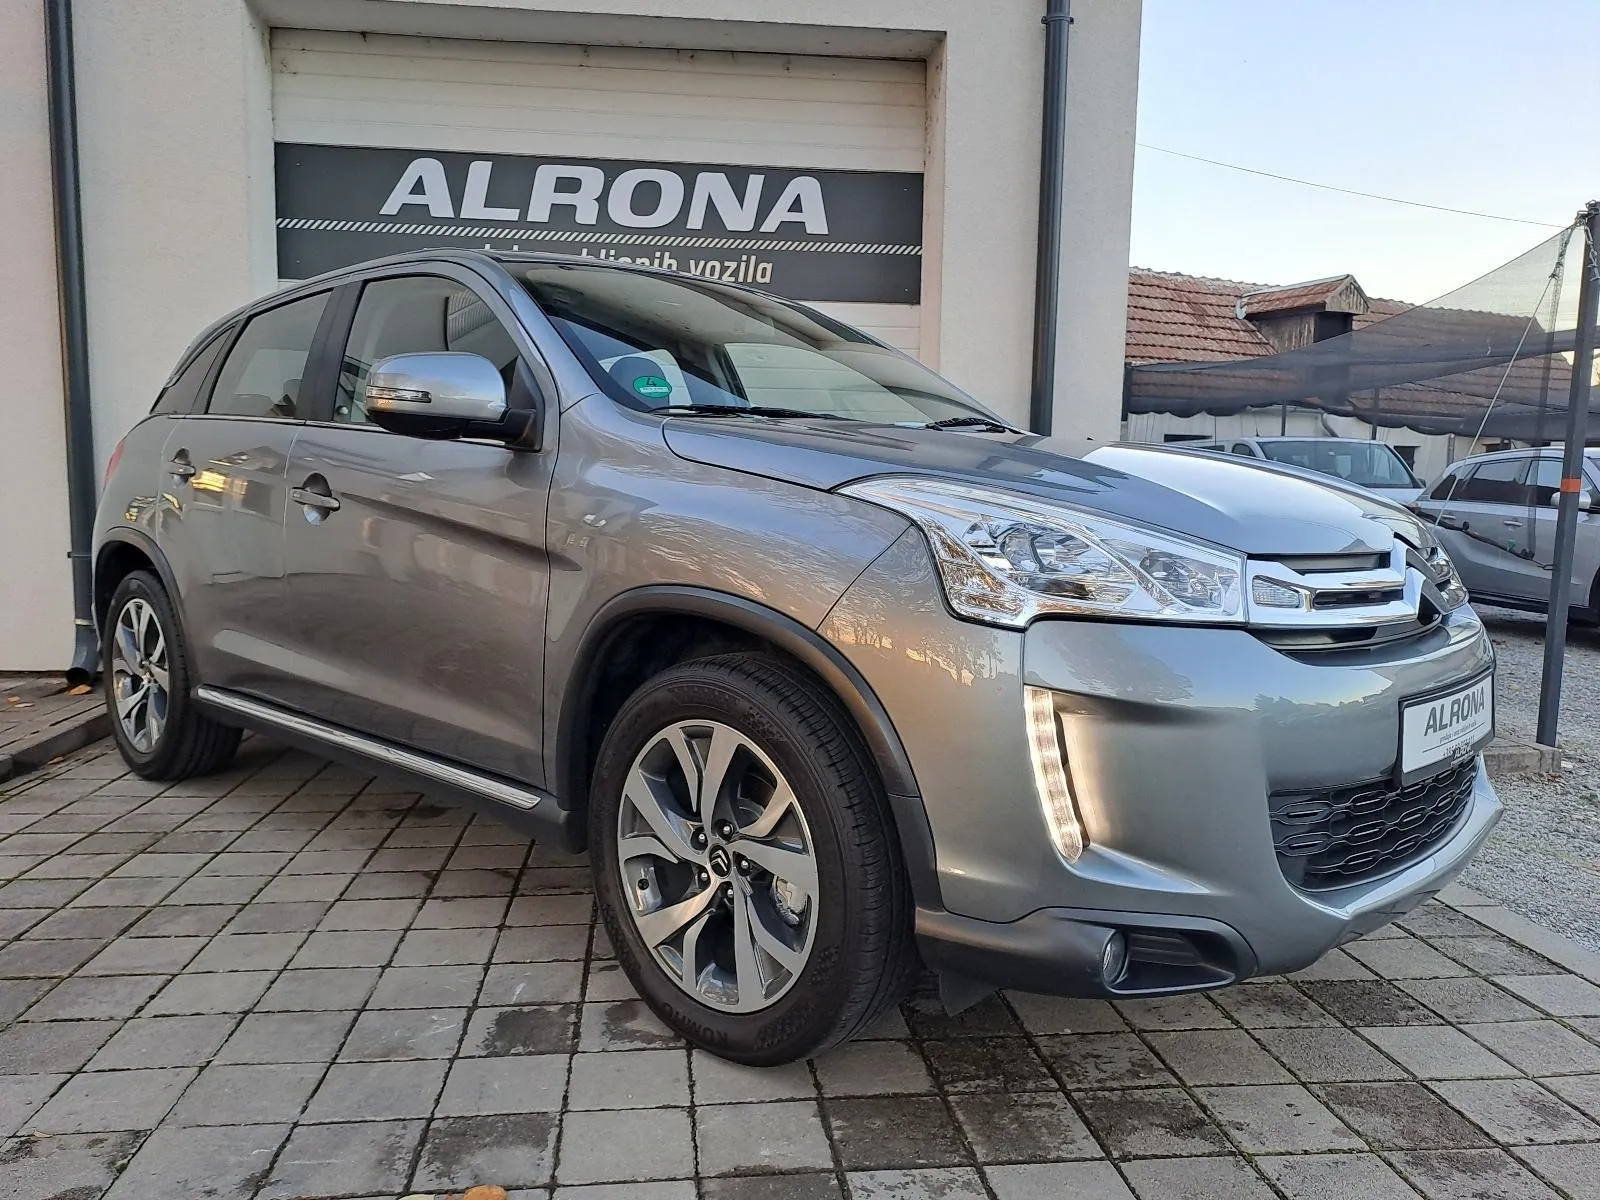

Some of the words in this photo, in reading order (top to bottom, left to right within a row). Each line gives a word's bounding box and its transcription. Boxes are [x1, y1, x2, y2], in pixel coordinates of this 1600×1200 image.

[378, 157, 829, 235] ALRONA
[689, 254, 773, 283] vozila
[1424, 686, 1485, 736] ALRONA
